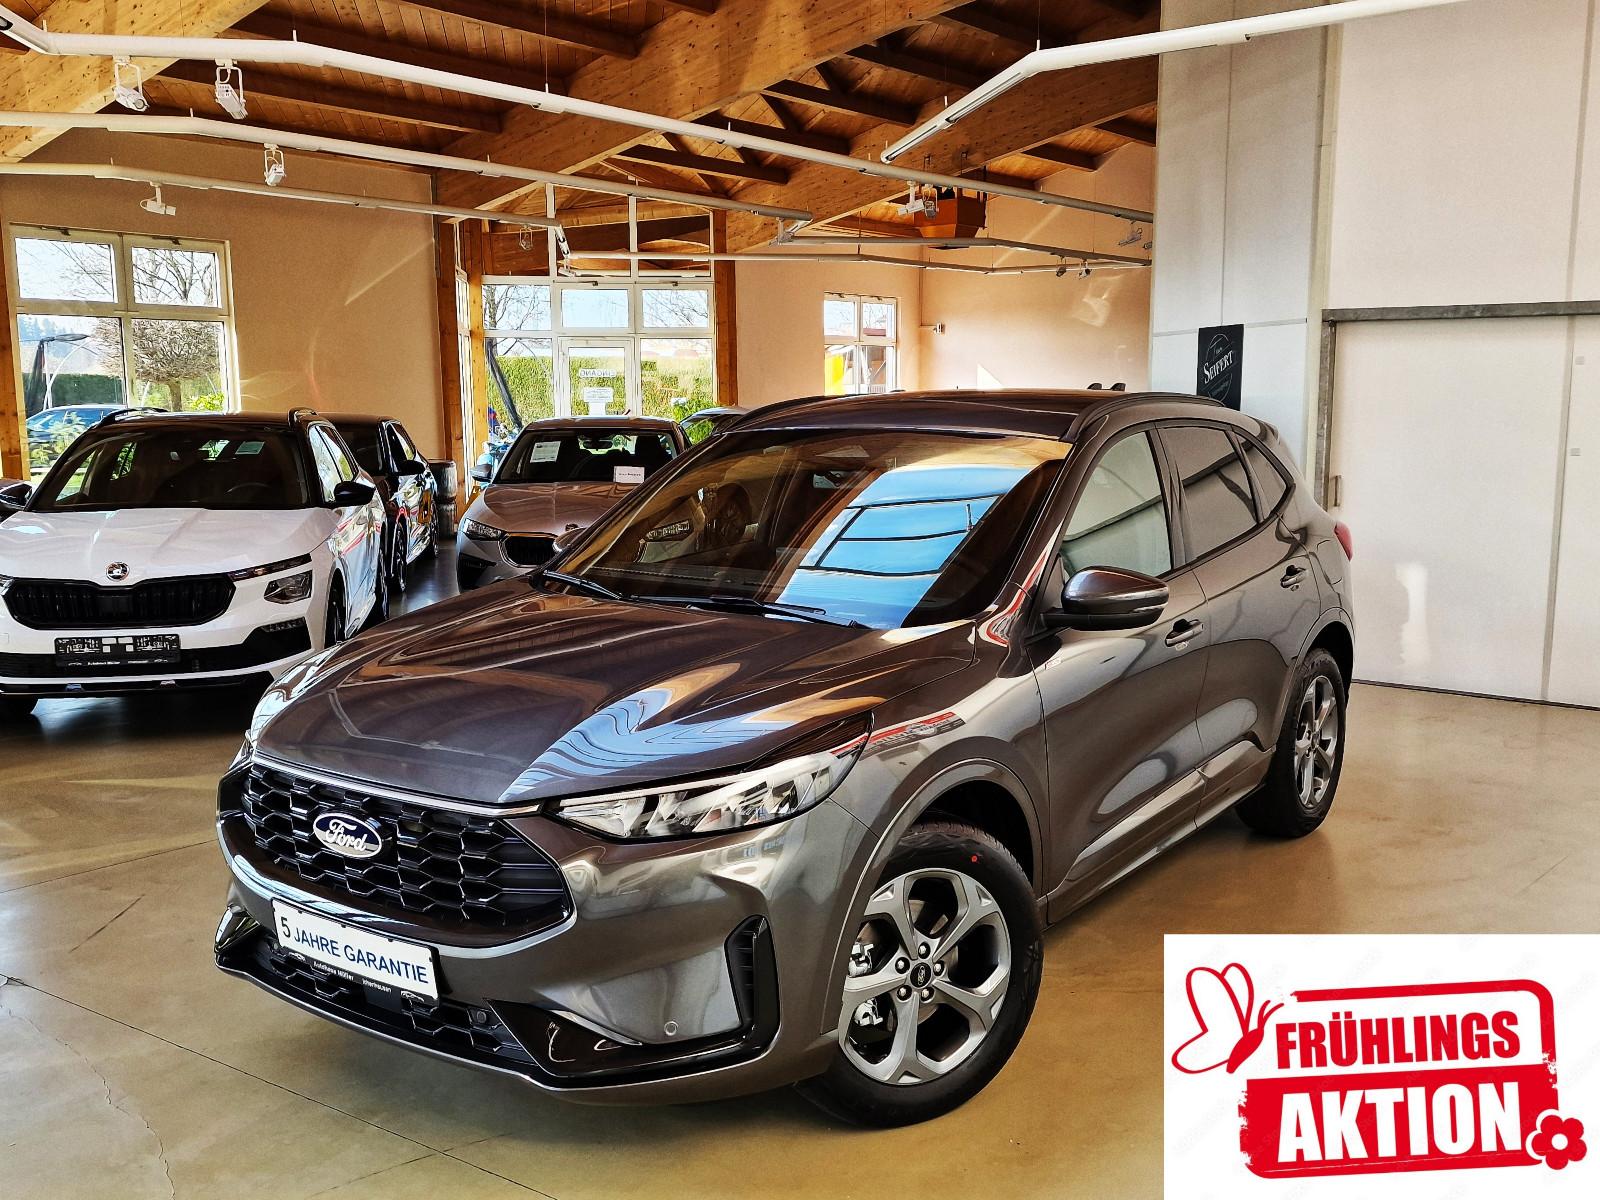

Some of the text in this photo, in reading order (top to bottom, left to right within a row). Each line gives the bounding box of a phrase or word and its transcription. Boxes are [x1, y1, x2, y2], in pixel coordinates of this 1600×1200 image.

[326, 818, 368, 851] Ford
[280, 916, 429, 984] 5 JAHRE GARANTIE
